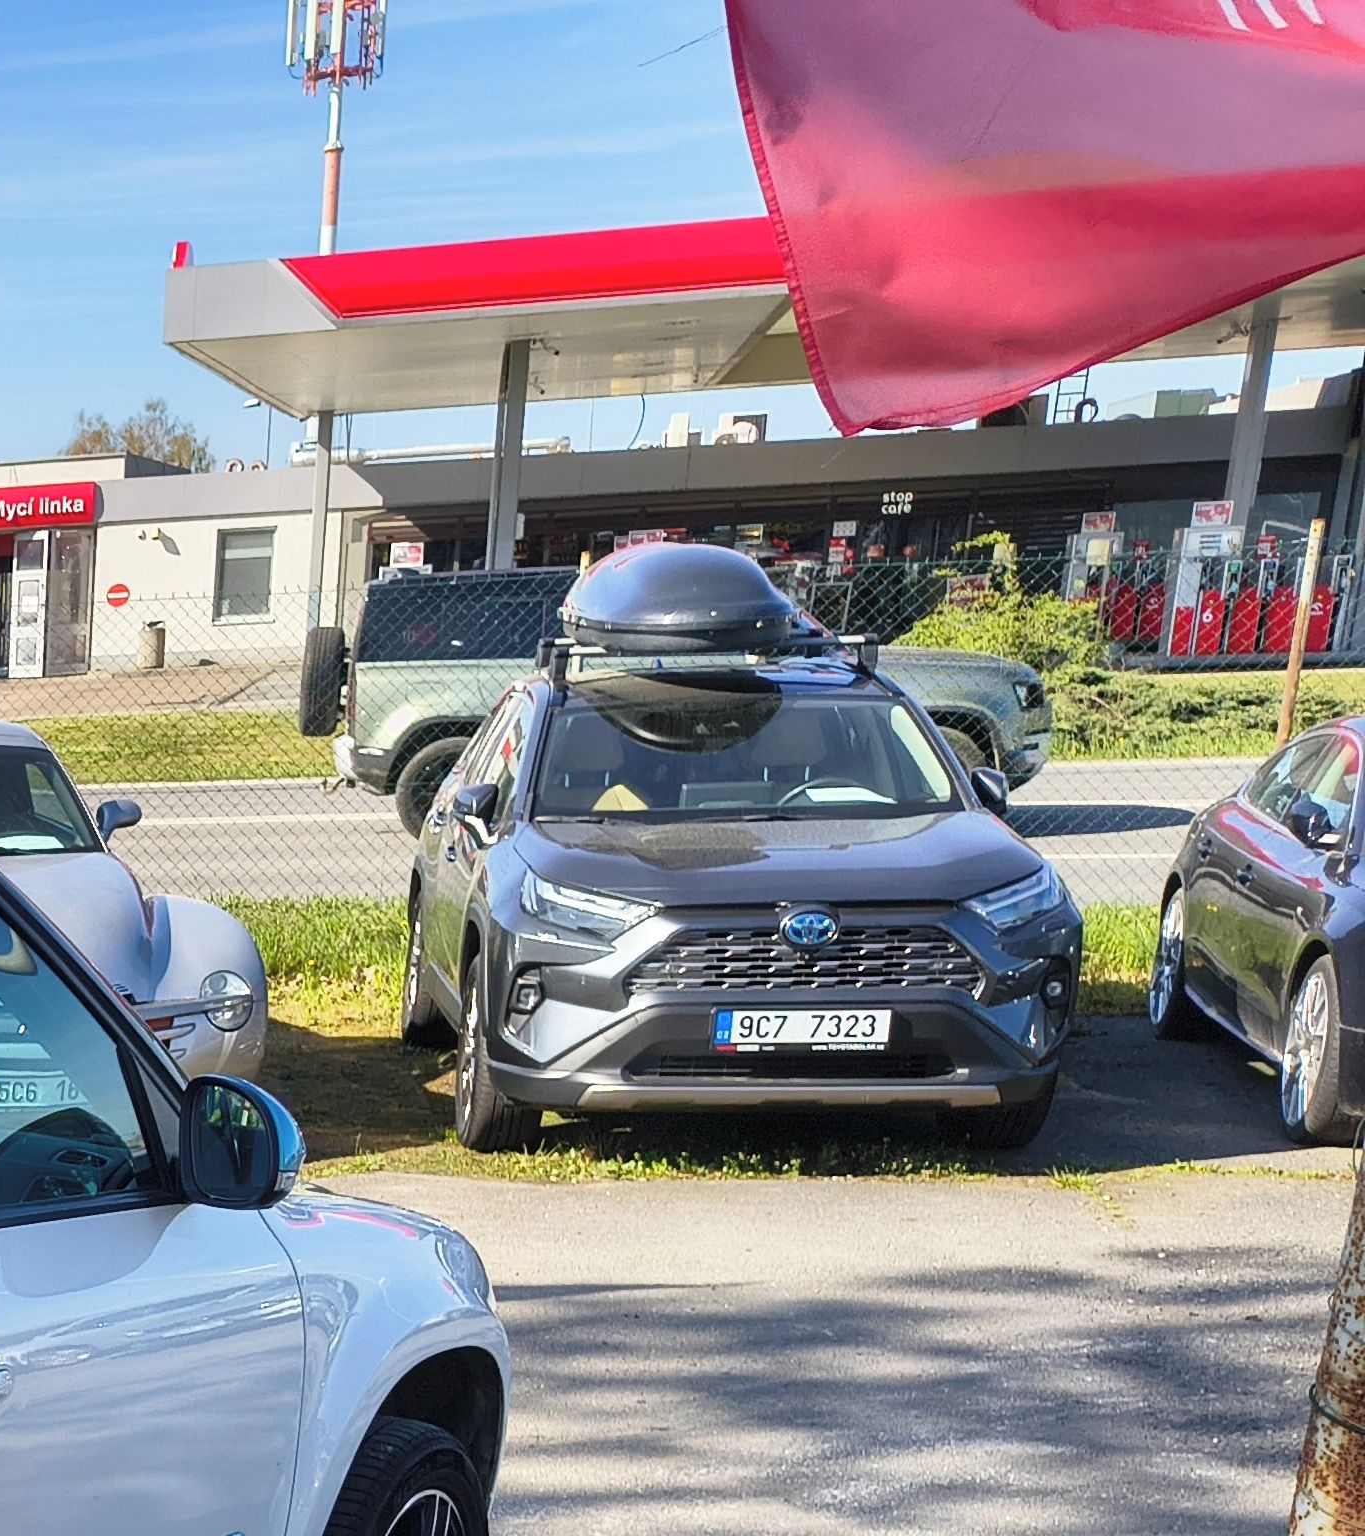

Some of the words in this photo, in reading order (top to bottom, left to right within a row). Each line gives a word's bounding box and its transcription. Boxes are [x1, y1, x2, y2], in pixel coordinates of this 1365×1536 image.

[39, 495, 84, 515] linka
[882, 491, 914, 503] stop
[1201, 608, 1214, 624] 6
[739, 1015, 788, 1039] 9C7
[810, 1014, 877, 1038] 7323
